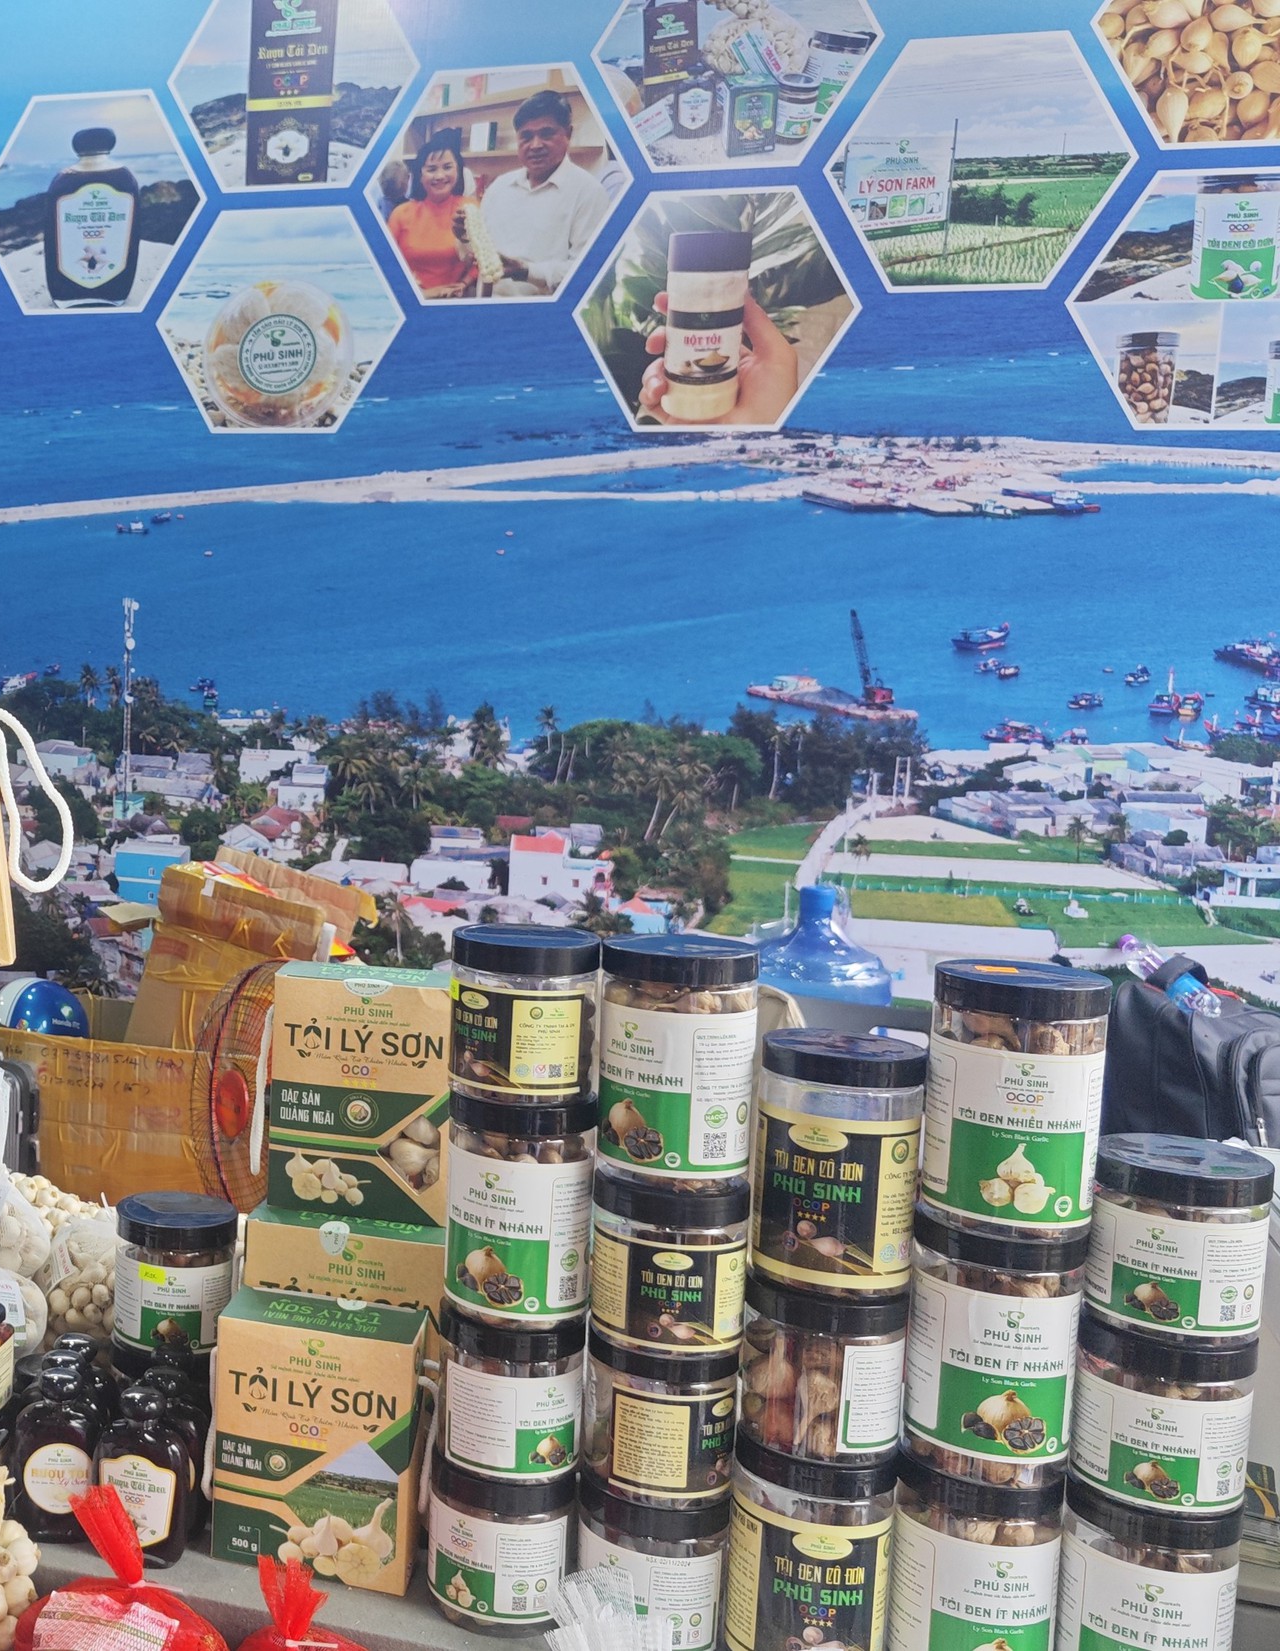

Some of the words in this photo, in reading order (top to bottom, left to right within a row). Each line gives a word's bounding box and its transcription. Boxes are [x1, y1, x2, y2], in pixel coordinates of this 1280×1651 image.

[859, 176, 874, 194] LÝ
[877, 178, 903, 193] SƠN
[905, 176, 936, 190] FARM
[253, 349, 274, 362] PHÚ
[278, 349, 302, 360] SINH
[343, 1005, 365, 1016] PHÚ
[368, 1009, 393, 1018] SINH
[52, 1018, 71, 1028] Honda
[284, 1018, 330, 1050] TỎI
[341, 1024, 373, 1053] LÝ
[381, 1030, 443, 1060] SƠN
[611, 1038, 628, 1052] PHÚ
[630, 1044, 655, 1057] SINH
[341, 1064, 378, 1076] OCOP
[1004, 1075, 1024, 1087] PHÚ
[1026, 1078, 1049, 1089] SINH
[281, 1089, 299, 1105] ĐẶC
[301, 1089, 320, 1106] SẢN
[1006, 1091, 1045, 1104] OCOP
[280, 1107, 309, 1122] QUẢNG
[313, 1109, 335, 1126] NGÃI
[958, 1106, 976, 1120] TỎI
[979, 1112, 1003, 1126] ĐEN
[1047, 1116, 1082, 1130] NHÁNH
[1013, 1133, 1030, 1141] Black
[1031, 1135, 1049, 1143] Garlic
[793, 1155, 815, 1176] ĐEN
[819, 1157, 836, 1179] CÔ
[839, 1162, 864, 1182] ĐƠN
[469, 1187, 487, 1201] PHÚ
[491, 1194, 516, 1206] SINH
[773, 1172, 807, 1197] PHÚ
[813, 1182, 862, 1204] SINH
[793, 1198, 830, 1212] OCOP
[1136, 1238, 1154, 1249] PHÚ
[1156, 1244, 1178, 1254] SINH
[328, 1262, 353, 1276] PHÚ
[356, 1267, 386, 1281] SINH
[641, 1285, 666, 1300] PHÚ
[671, 1290, 701, 1302] SINH
[983, 1326, 1009, 1342] PHÚ
[1014, 1333, 1042, 1344] SINH
[289, 1355, 312, 1367] PHÚ
[315, 1360, 341, 1372] SINH
[949, 1347, 969, 1363] TỎI
[974, 1355, 1001, 1370] ĐEN
[1006, 1356, 1018, 1371] ÍT
[1023, 1359, 1064, 1373] NHÁNH
[228, 1366, 277, 1402] TỎI
[288, 1378, 323, 1409] LÝ
[330, 1387, 397, 1421] SƠN
[289, 1422, 329, 1437] OCOP
[1136, 1418, 1154, 1428] PHÚ
[1156, 1424, 1177, 1433] SINH
[1131, 1438, 1148, 1449] ĐEN
[1151, 1439, 1160, 1451] ÍT
[1163, 1445, 1196, 1456] NHÁNH
[238, 1524, 251, 1533] KLT
[232, 1537, 249, 1548] 500
[250, 1543, 258, 1552] g
[799, 1563, 821, 1583] ĐEN
[826, 1565, 841, 1584] CÔ
[845, 1566, 865, 1585] ĐƠN
[773, 1578, 812, 1603] PHÚ
[820, 1589, 863, 1606] SINH
[974, 1578, 1000, 1592] PHÚ
[1004, 1582, 1029, 1592] SINH
[799, 1605, 837, 1616] OCOP
[940, 1595, 960, 1612] TỎI
[965, 1605, 991, 1619] ĐEN
[996, 1604, 1007, 1619] ÍT
[1012, 1603, 1048, 1620] NHÁNH
[1121, 1597, 1148, 1614] PHÚ
[1152, 1607, 1183, 1620] SINH
[1089, 1612, 1107, 1630] TỎI
[1112, 1624, 1138, 1641] ĐEN
[1144, 1629, 1156, 1646] ÍT
[1162, 1636, 1208, 1648] NHÁNH
